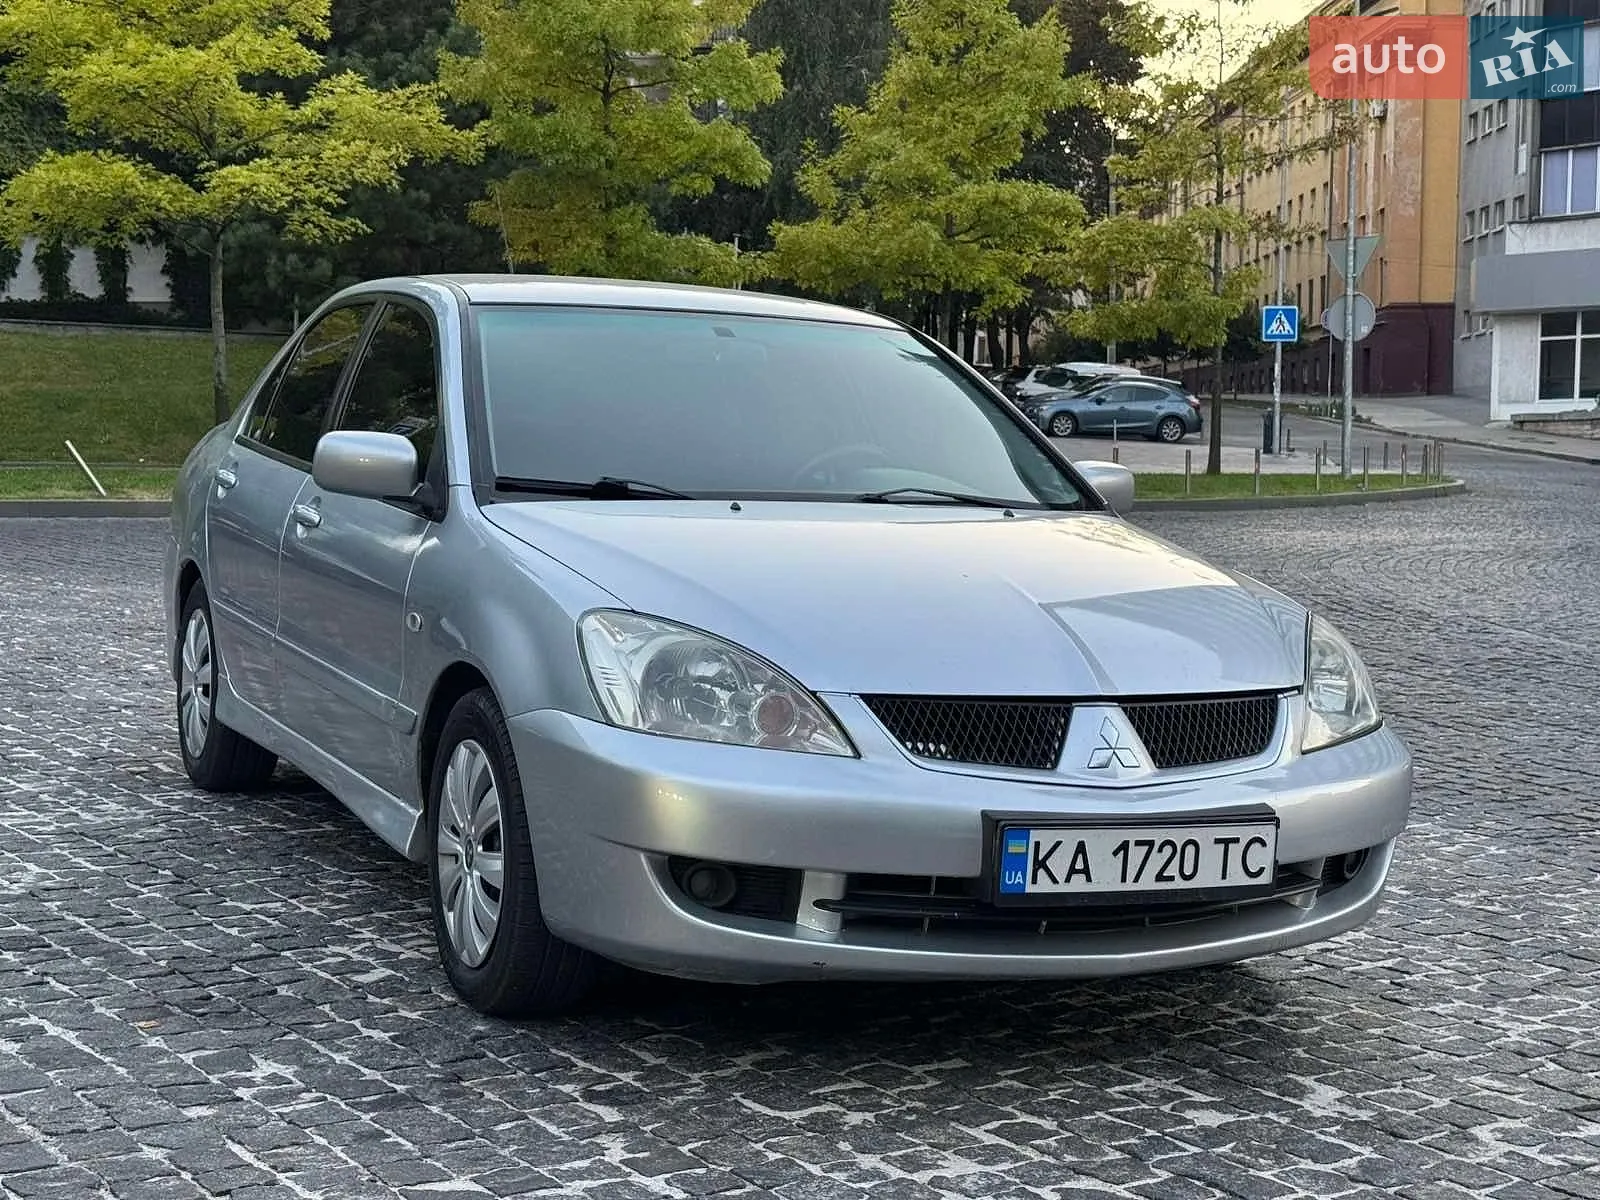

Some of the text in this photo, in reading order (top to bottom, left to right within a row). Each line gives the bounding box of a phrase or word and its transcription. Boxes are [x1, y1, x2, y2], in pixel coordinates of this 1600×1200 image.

[1030, 836, 1268, 885] KA 1720 TC
[1005, 871, 1024, 885] UA
